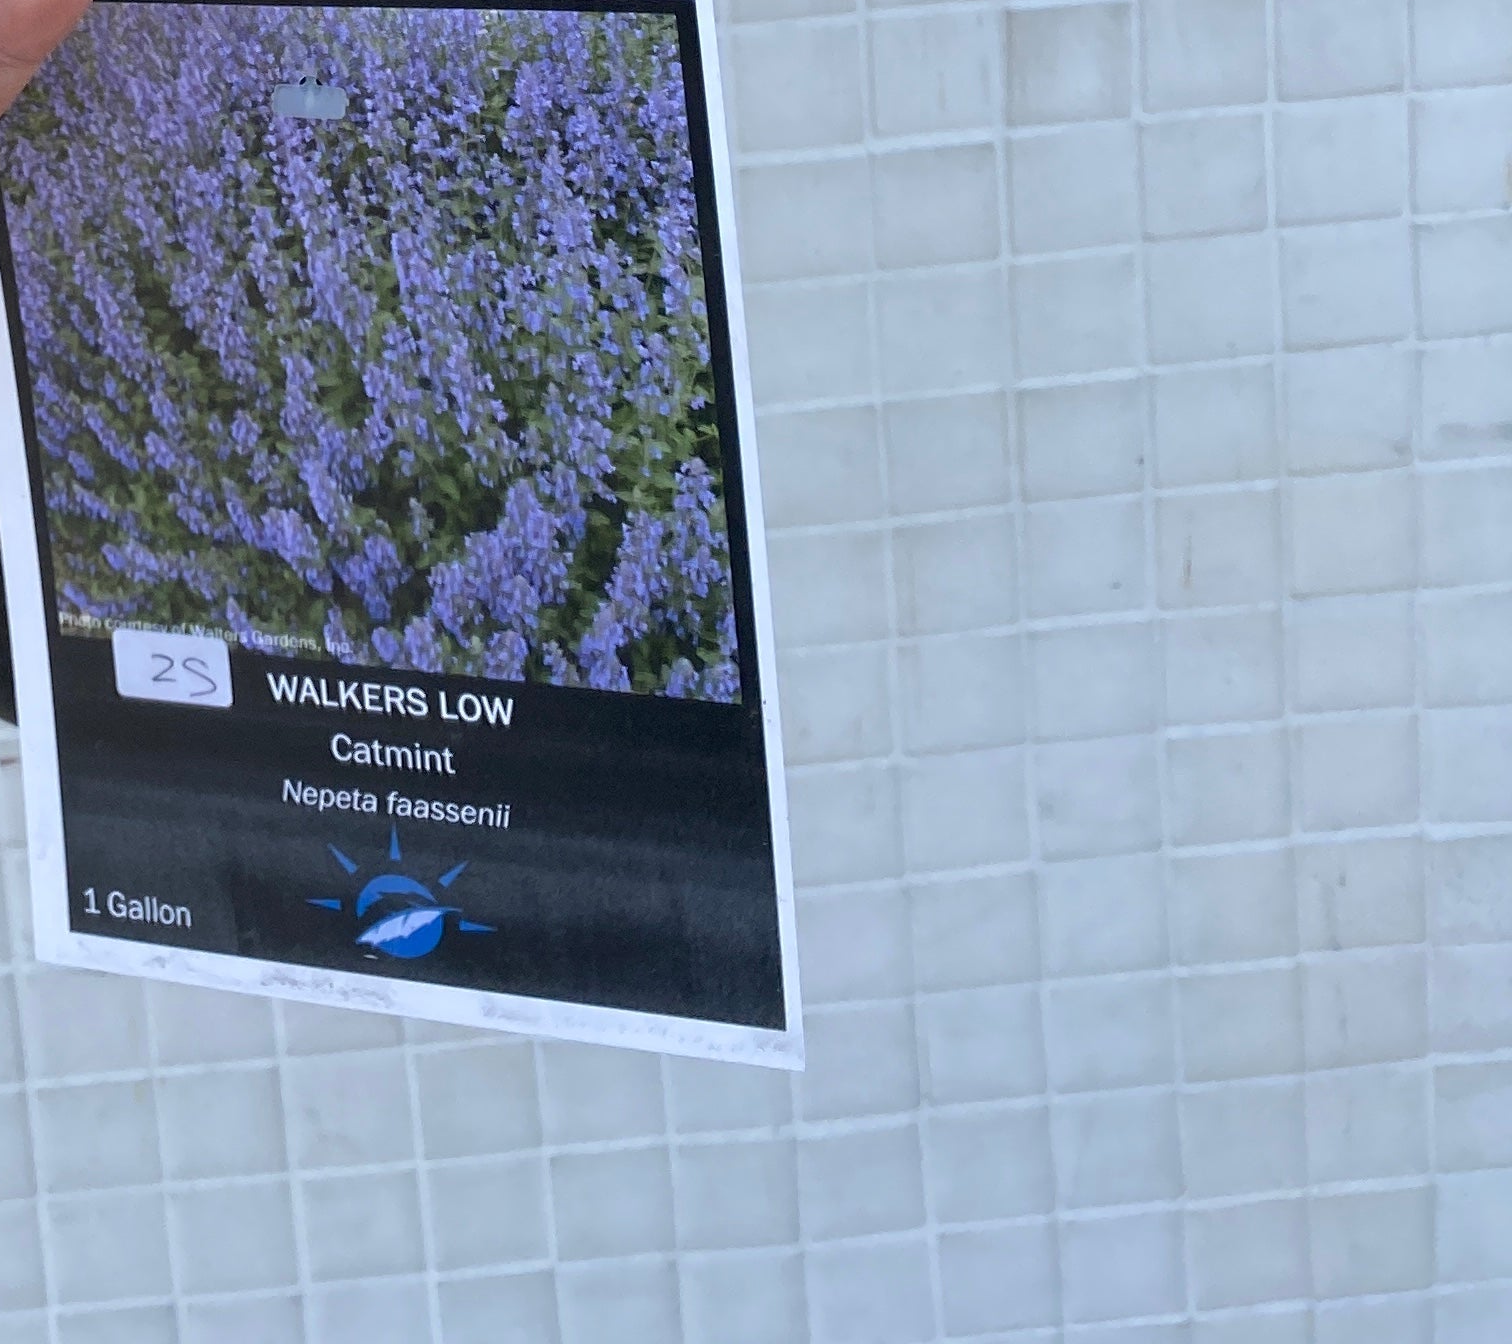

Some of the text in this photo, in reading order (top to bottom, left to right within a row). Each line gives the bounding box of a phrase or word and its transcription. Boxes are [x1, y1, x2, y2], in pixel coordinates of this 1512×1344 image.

[253, 630, 322, 652] Gardens,
[266, 672, 514, 726] WALKERS LOW
[330, 733, 456, 774] Catmint
[282, 779, 511, 829] Nepeta faassenii
[83, 887, 192, 928] 1 Gallon
